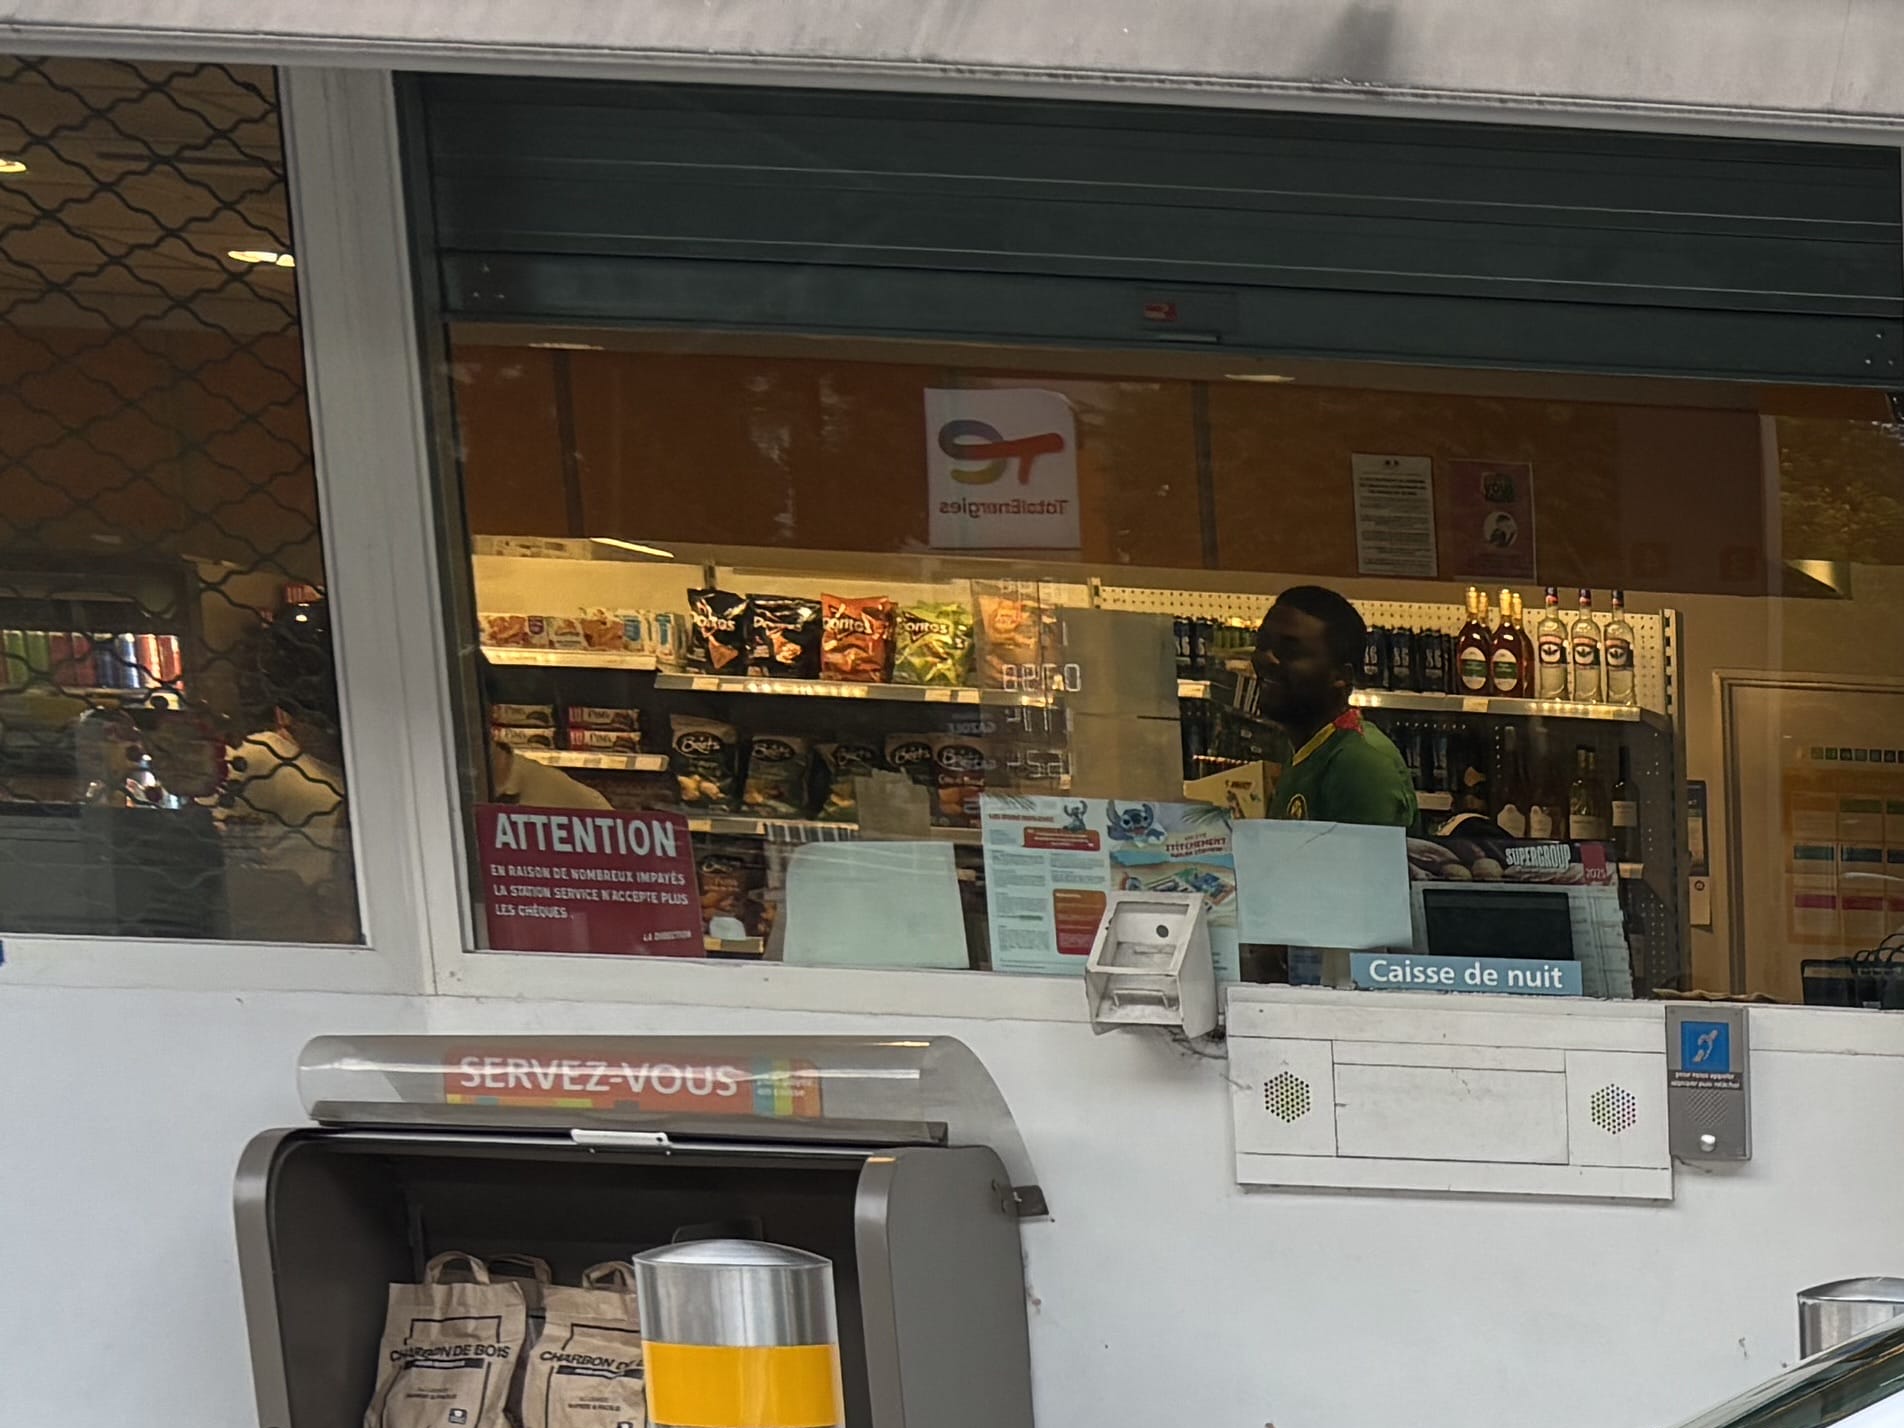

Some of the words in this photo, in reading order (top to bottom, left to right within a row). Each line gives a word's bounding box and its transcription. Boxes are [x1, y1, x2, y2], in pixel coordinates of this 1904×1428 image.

[495, 813, 677, 857] ATTENTION
[1505, 844, 1571, 870] SUPERGROUP
[490, 864, 505, 876] EN
[508, 864, 550, 878] RAISON
[553, 867, 569, 879] DE
[571, 868, 633, 883] NOMBREUX
[494, 885, 507, 896] LA
[510, 886, 551, 899] STATION
[554, 887, 599, 901] SERVICE
[661, 892, 688, 906] PLUS
[495, 904, 515, 916] LES
[1369, 959, 1455, 984] Caisse
[1464, 961, 1498, 986] de
[1507, 964, 1563, 989] nuit
[460, 1055, 738, 1097] SERVEZ-VOUS
[451, 1344, 471, 1358] DE
[474, 1344, 511, 1359] BOIS
[540, 1351, 613, 1368] CHARBON
